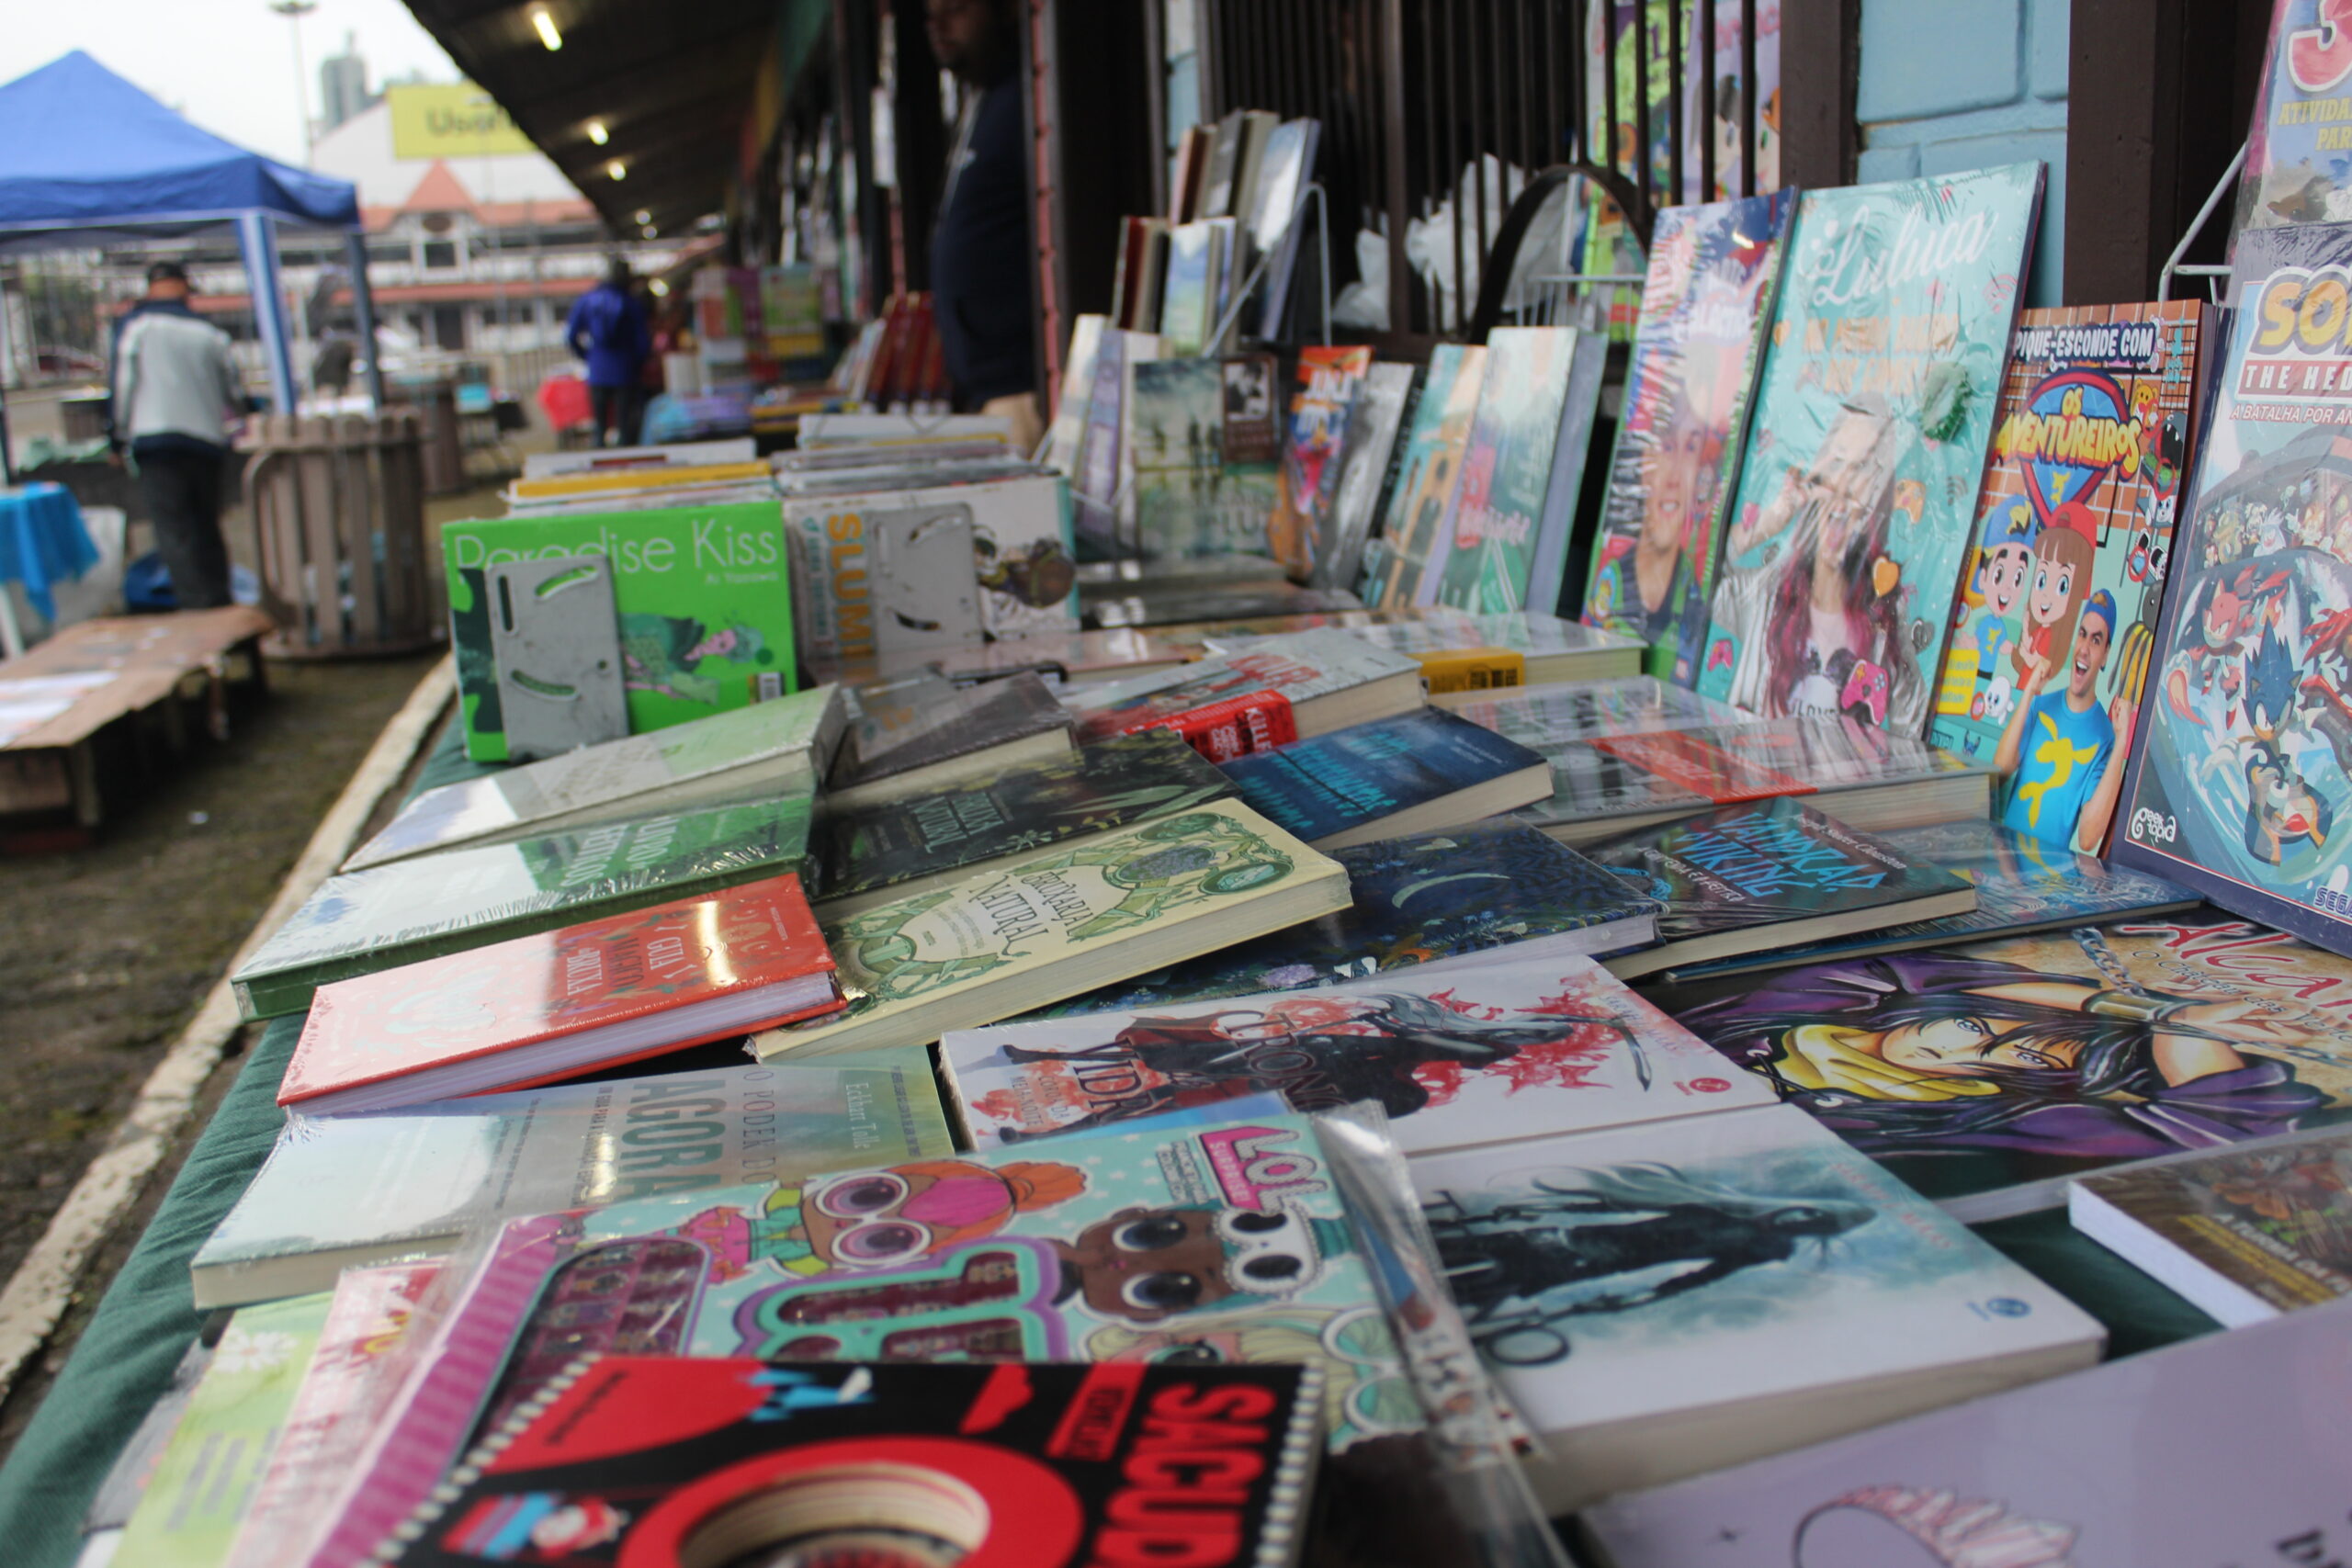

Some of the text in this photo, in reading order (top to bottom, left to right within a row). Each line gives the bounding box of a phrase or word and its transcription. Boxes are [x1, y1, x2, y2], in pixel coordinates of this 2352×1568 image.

[1797, 204, 1999, 307] Luluca
[2014, 327, 2154, 359] PIQUE-ESCONDE COM
[2256, 273, 2352, 353] SO
[2062, 386, 2084, 417] OS
[2245, 365, 2291, 389] THE
[1992, 409, 2143, 478] AVENTUREIROS
[2231, 404, 2243, 420] A
[2243, 404, 2304, 423] BATALHA
[2303, 406, 2334, 424] POR
[692, 518, 779, 570] Kiss
[1671, 834, 1817, 897] VIKING
[969, 874, 1050, 954] NATURAL
[1020, 865, 1095, 935] BRUXARIA
[567, 947, 602, 998] BRUXA
[649, 938, 684, 970] GUIA
[1011, 1076, 1045, 1128] MEIA-NOITE
[1038, 1075, 1071, 1121] COROA DA
[1071, 1036, 1156, 1112] VIDR
[619, 1077, 728, 1198] AGORA
[741, 1069, 776, 1185] O PODER DO
[845, 1081, 880, 1150] Eckhart Tolle
[1209, 1141, 1252, 1202] SURPRISE!
[1231, 1129, 1329, 1213] LOL
[1091, 1382, 1276, 1568] SACUD
